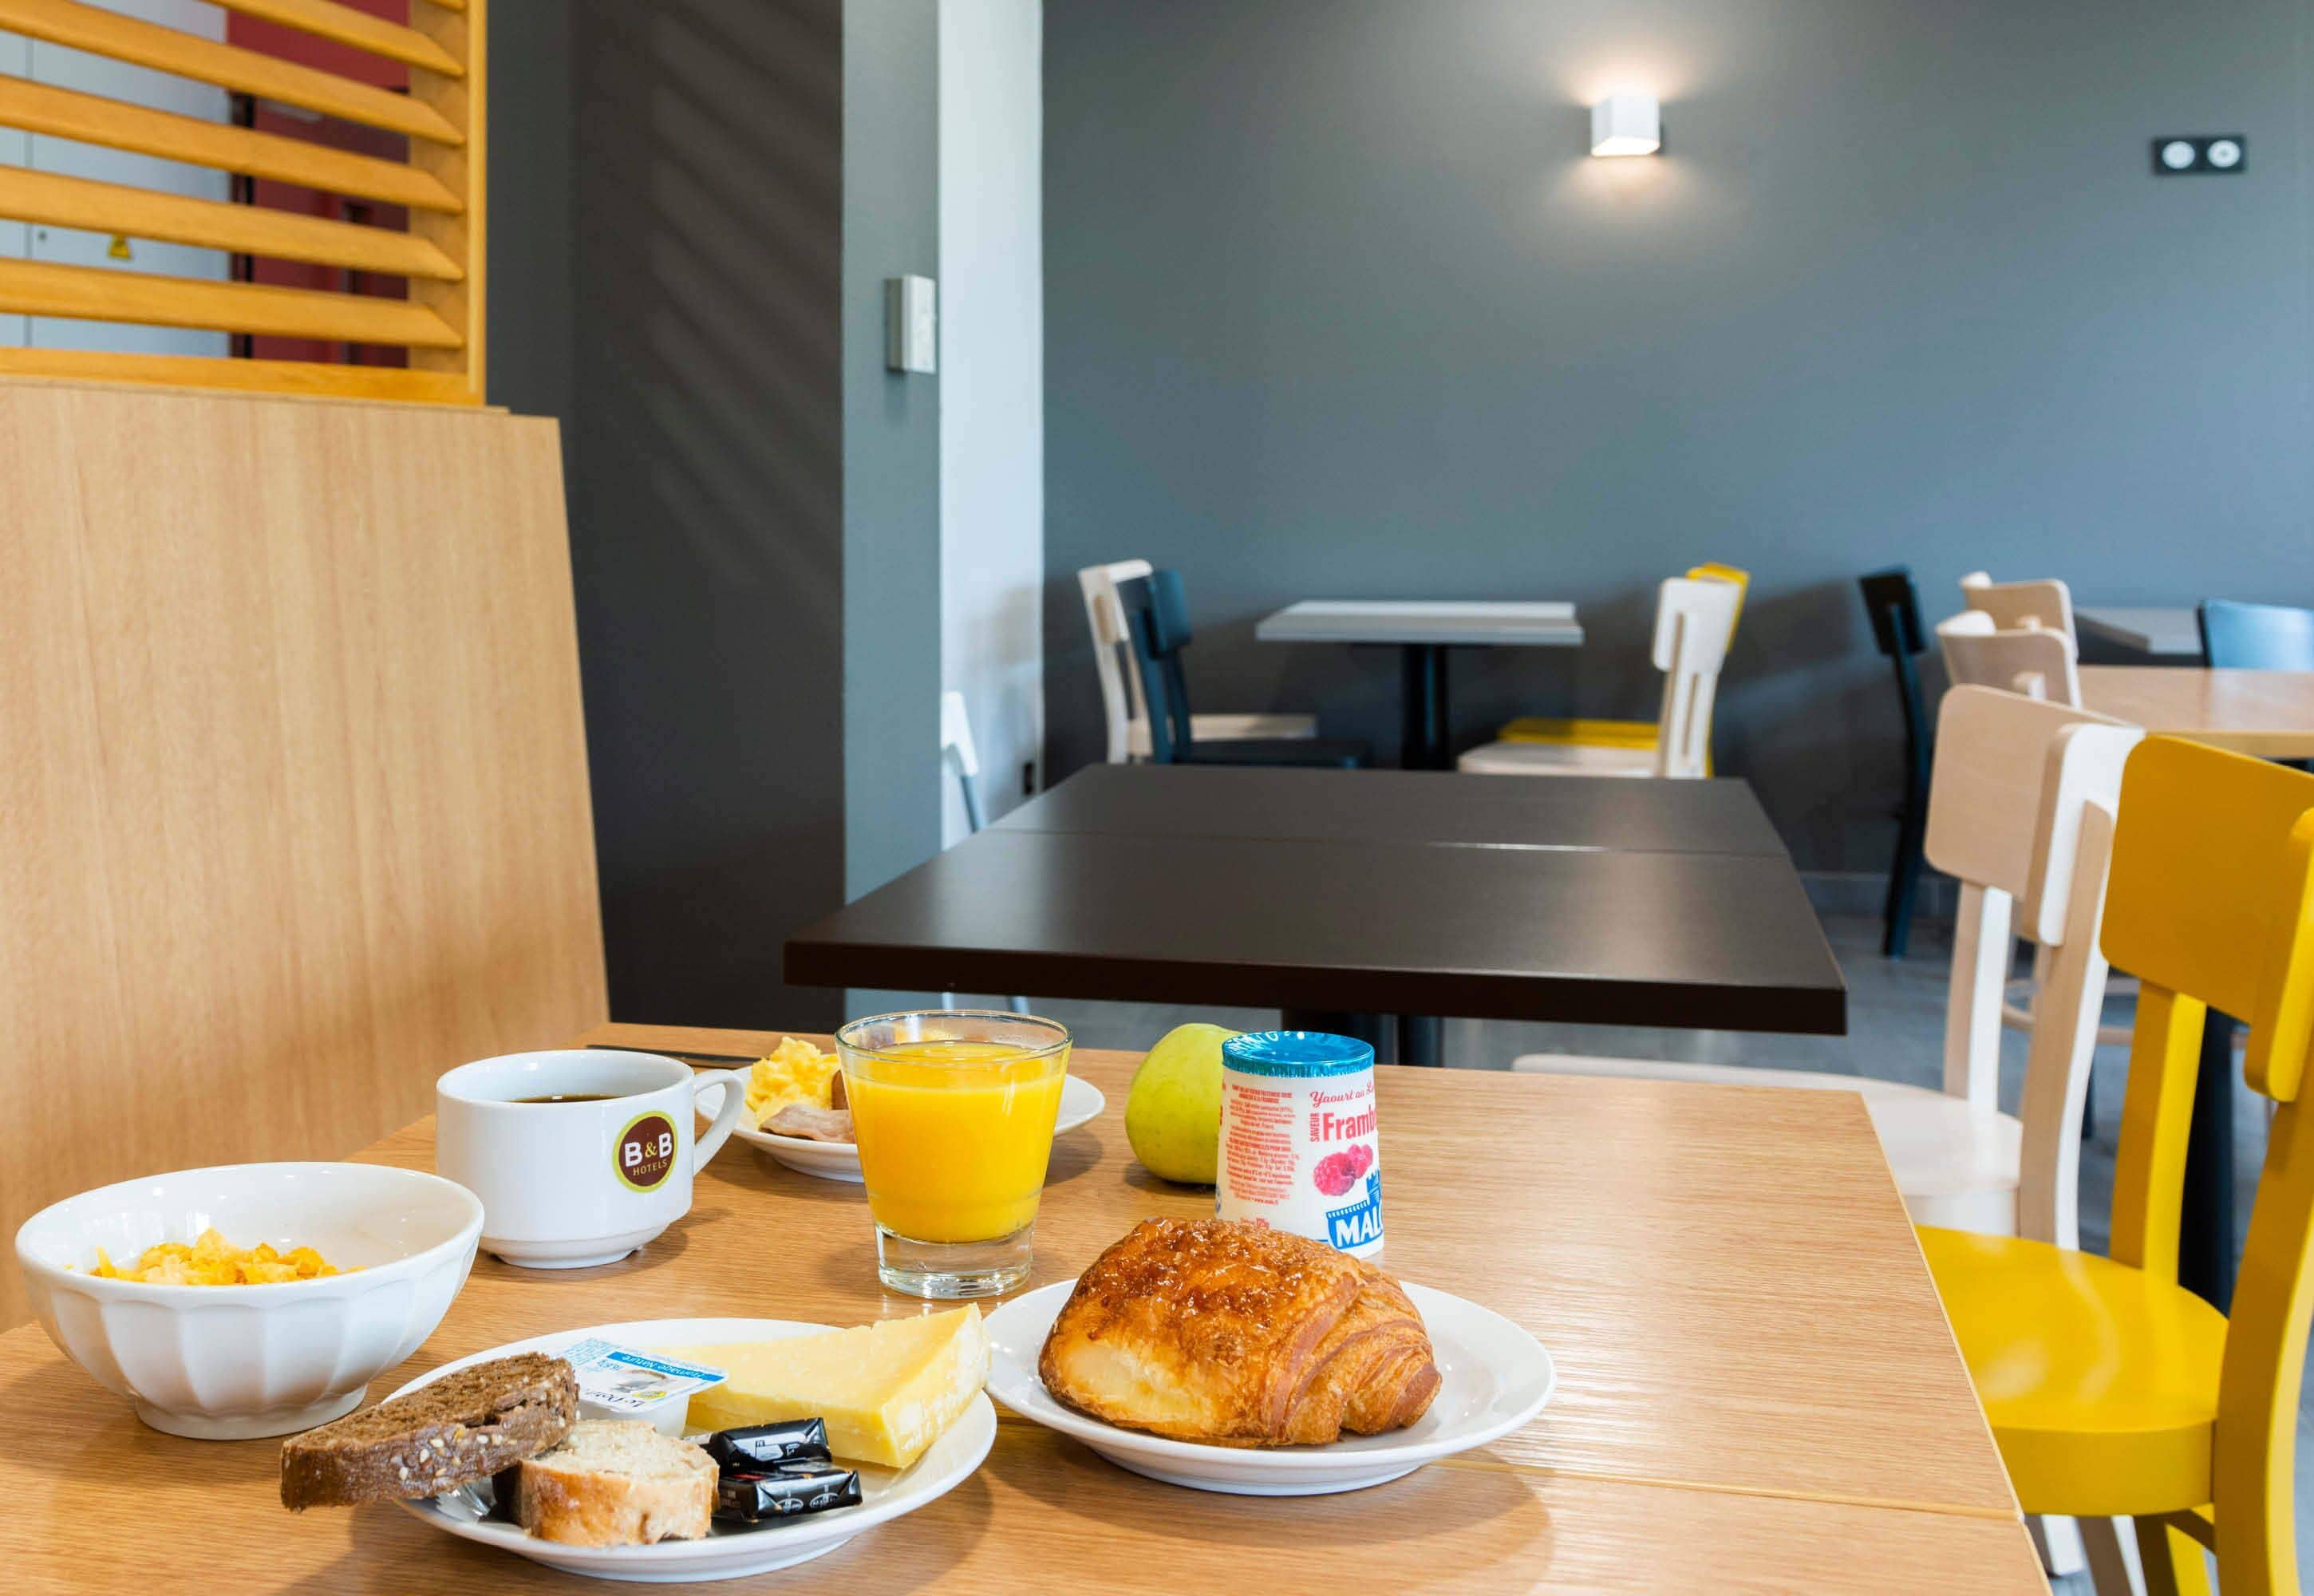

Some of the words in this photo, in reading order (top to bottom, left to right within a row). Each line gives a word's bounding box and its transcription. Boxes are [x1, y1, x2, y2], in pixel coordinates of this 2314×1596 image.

[1309, 1090, 1354, 1108] Yaourt
[1355, 1090, 1365, 1099] au
[1309, 1112, 1321, 1142] SAVEUR
[1323, 1104, 1378, 1141] Framb
[625, 1132, 673, 1167] B&B
[633, 1159, 668, 1176] HOTELS
[1336, 1206, 1383, 1247] MAL
[622, 1355, 657, 1369] Nature
